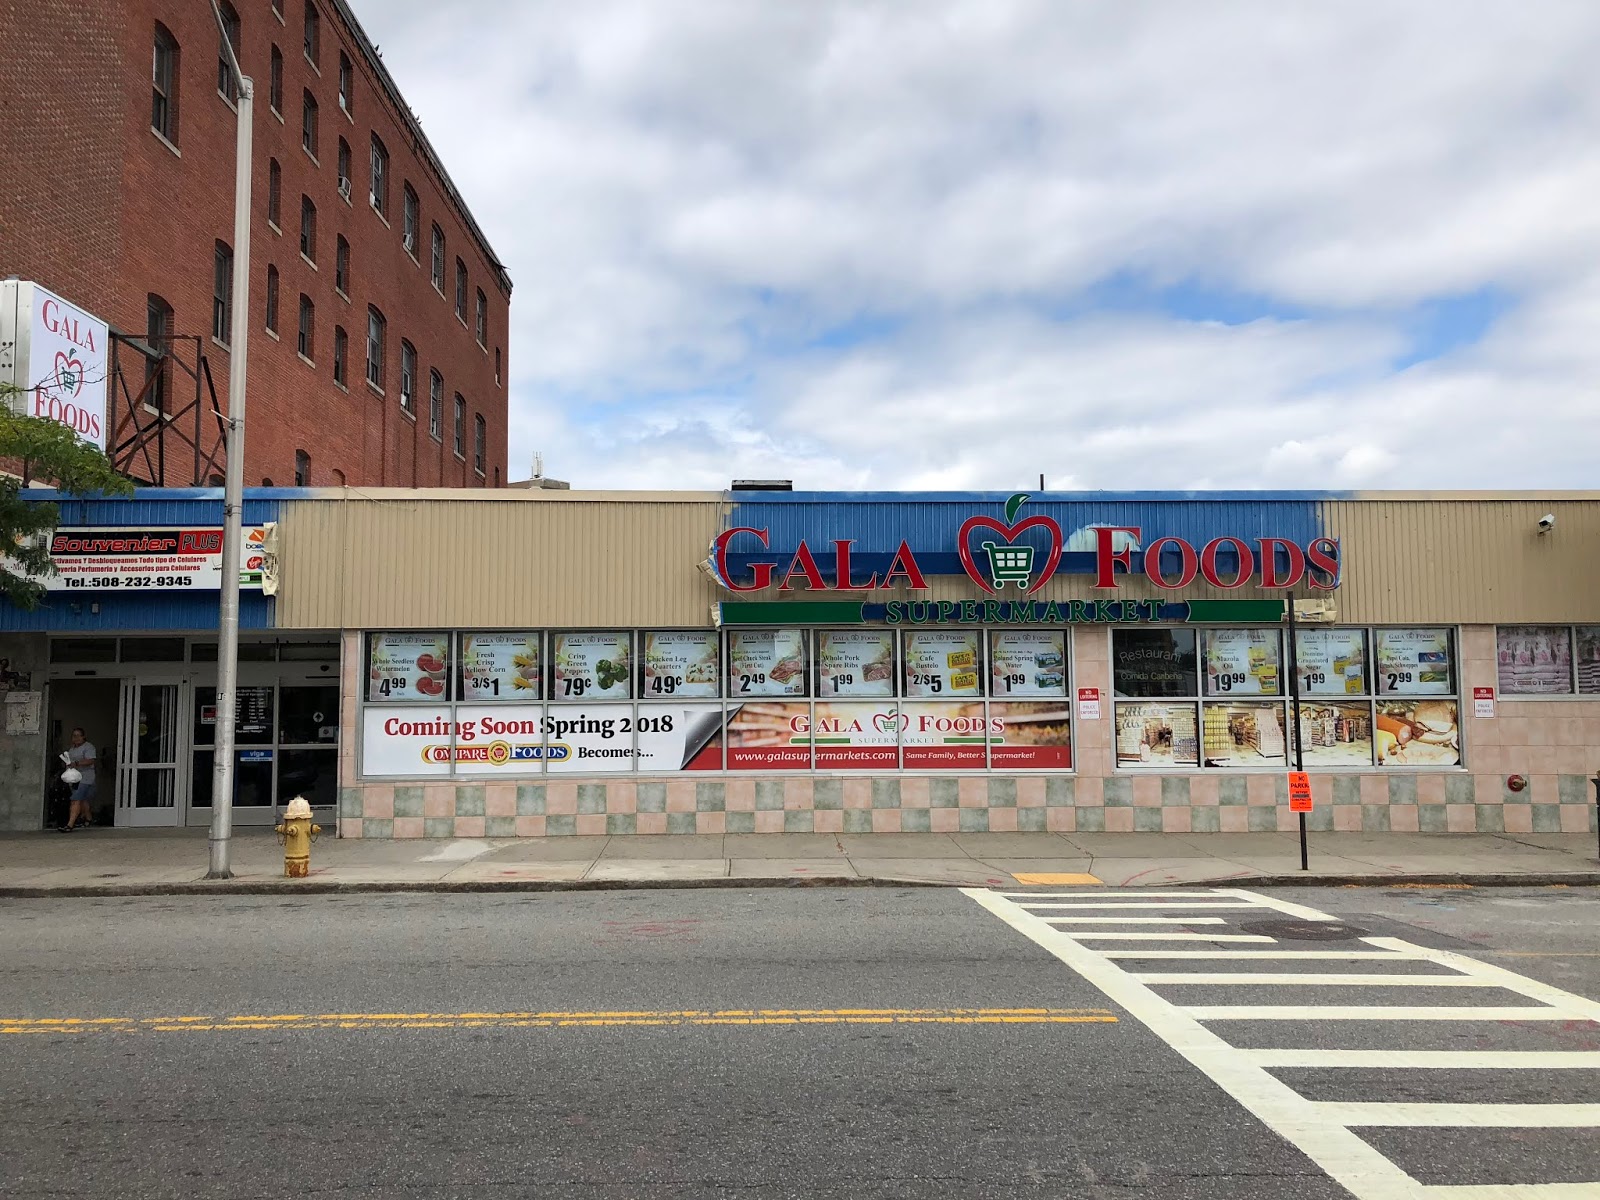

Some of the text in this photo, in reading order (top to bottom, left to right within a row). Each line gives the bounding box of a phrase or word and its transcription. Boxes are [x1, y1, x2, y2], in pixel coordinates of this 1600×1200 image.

[42, 299, 96, 353] GALA
[34, 385, 100, 439] FOODS
[52, 532, 220, 552] Souvenier PLUS
[155, 556, 168, 565] tipo
[716, 526, 1342, 591] GALA FOODS
[64, 576, 192, 588] Tel.:508-232-9345
[885, 598, 1166, 624] SUPERMARKET
[1118, 648, 1182, 664] Restaurant
[1120, 671, 1149, 681] Comida
[384, 714, 674, 741] Coming Soon Spring 2018
[790, 715, 1005, 733] GALA FOODS
[511, 743, 566, 759] FOODS
[734, 750, 896, 763] www.galasupermarkets.com
[927, 752, 956, 761] Family,
[957, 751, 980, 759] Better
